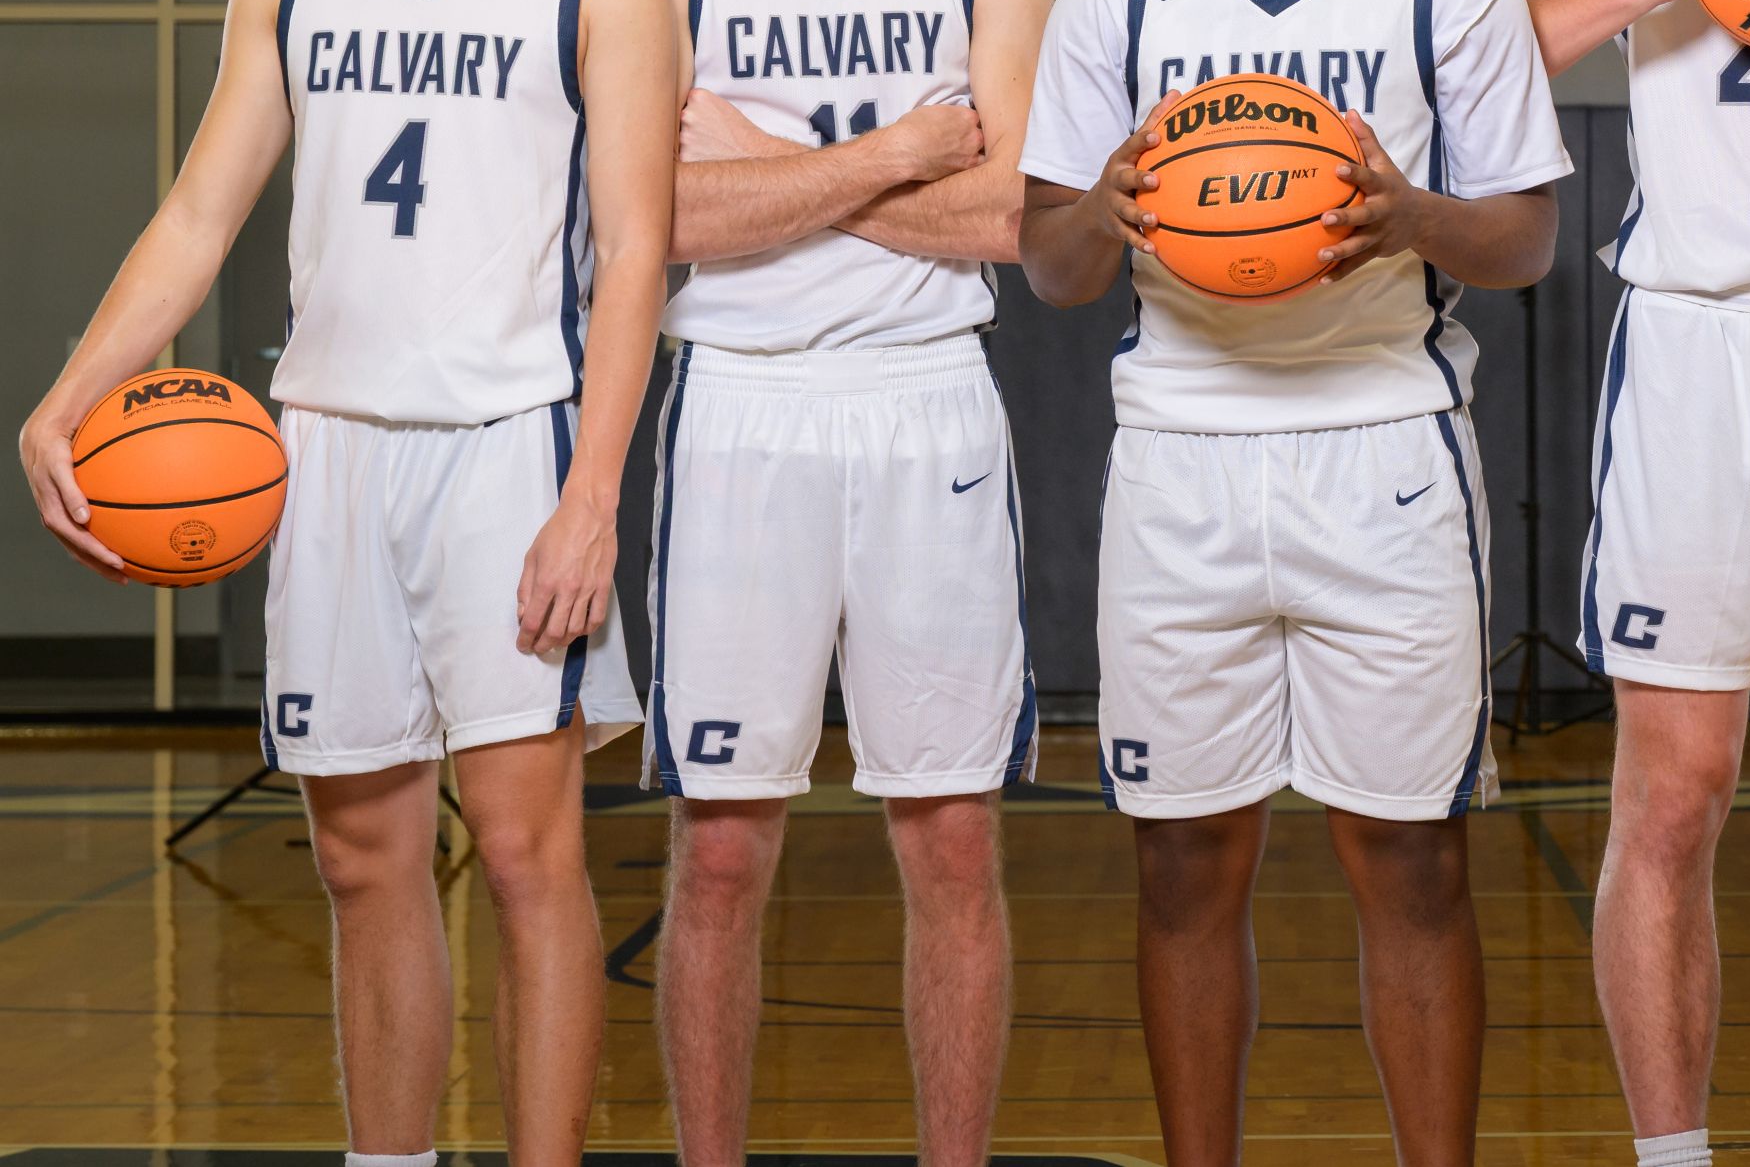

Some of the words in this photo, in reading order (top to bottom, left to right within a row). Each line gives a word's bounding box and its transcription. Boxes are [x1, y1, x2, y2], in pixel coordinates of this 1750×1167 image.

[306, 29, 526, 101] CALVARY
[726, 10, 945, 79] CALVARY
[1164, 93, 1319, 143] Wilson
[361, 118, 430, 240] 4
[1291, 167, 1319, 180] NXT
[123, 378, 232, 413] NCAA
[123, 401, 168, 420] OFFICIAL
[170, 397, 202, 405] GAME
[204, 399, 232, 410] BALL
[1610, 601, 1667, 651] C
[276, 691, 314, 739] C
[684, 719, 743, 765] C
[1112, 737, 1149, 784] C
